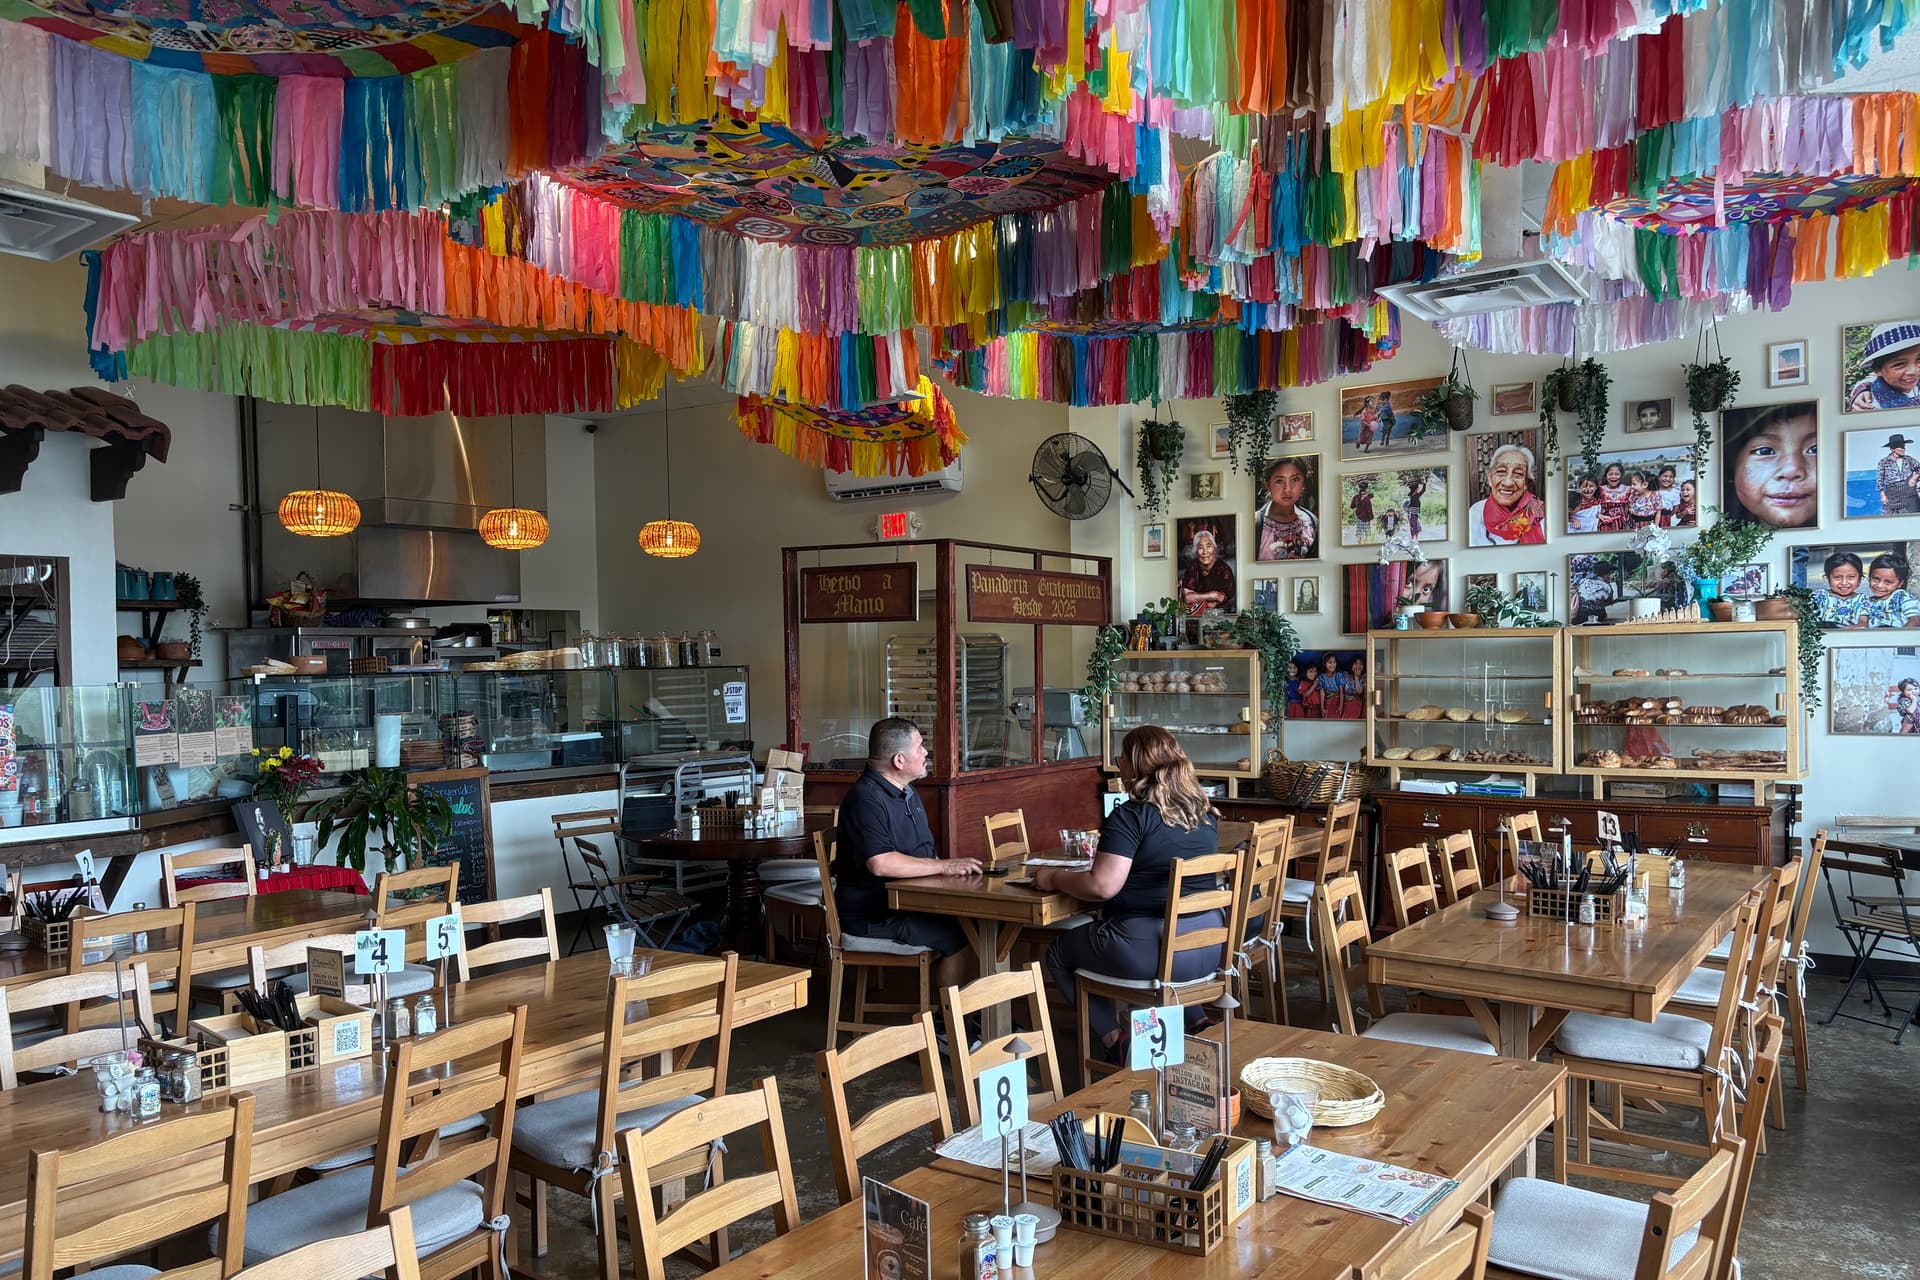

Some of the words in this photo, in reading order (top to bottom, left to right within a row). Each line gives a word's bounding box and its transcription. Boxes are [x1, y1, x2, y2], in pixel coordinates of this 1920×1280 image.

[881, 512, 907, 539] EXIT
[817, 574, 861, 594] Hecho
[882, 574, 892, 590] a
[833, 594, 885, 616] Mano
[1012, 596, 1042, 617] Desde
[1051, 599, 1077, 618] 2025
[729, 686, 742, 694] STOP
[1601, 815, 1617, 836] 13
[83, 856, 92, 878] 2
[438, 923, 449, 951] 5
[371, 937, 388, 965] 4
[1150, 1017, 1167, 1058] 9
[1172, 1067, 1193, 1079] FOLLOW
[1172, 1074, 1211, 1093] INSTAGRAM
[996, 1075, 1012, 1122] 8
[900, 1209, 927, 1234] Café
